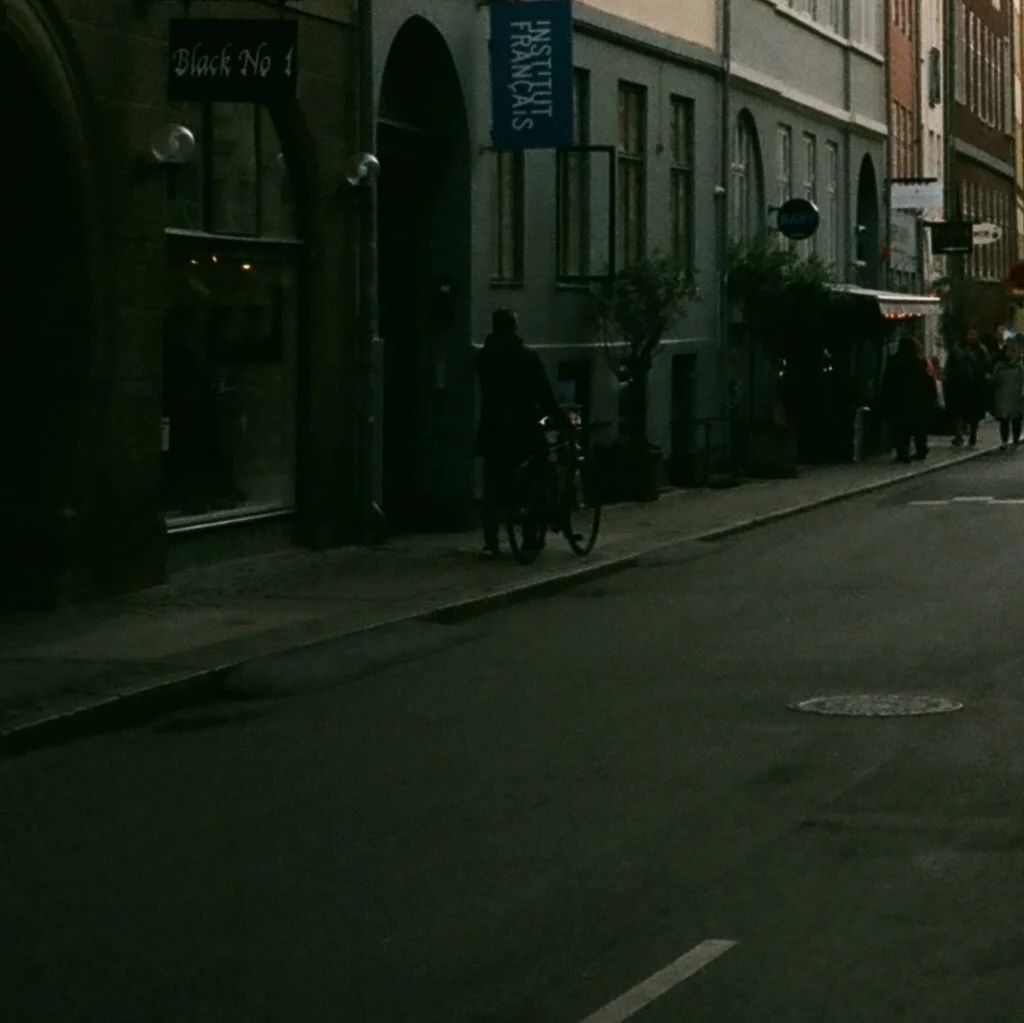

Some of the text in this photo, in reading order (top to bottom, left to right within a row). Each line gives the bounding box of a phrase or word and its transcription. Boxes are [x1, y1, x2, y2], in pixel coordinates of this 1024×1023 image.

[172, 42, 295, 79] Black No 1
[508, 21, 534, 132] FRANÇAIS
[531, 19, 554, 118] INSTITUT
